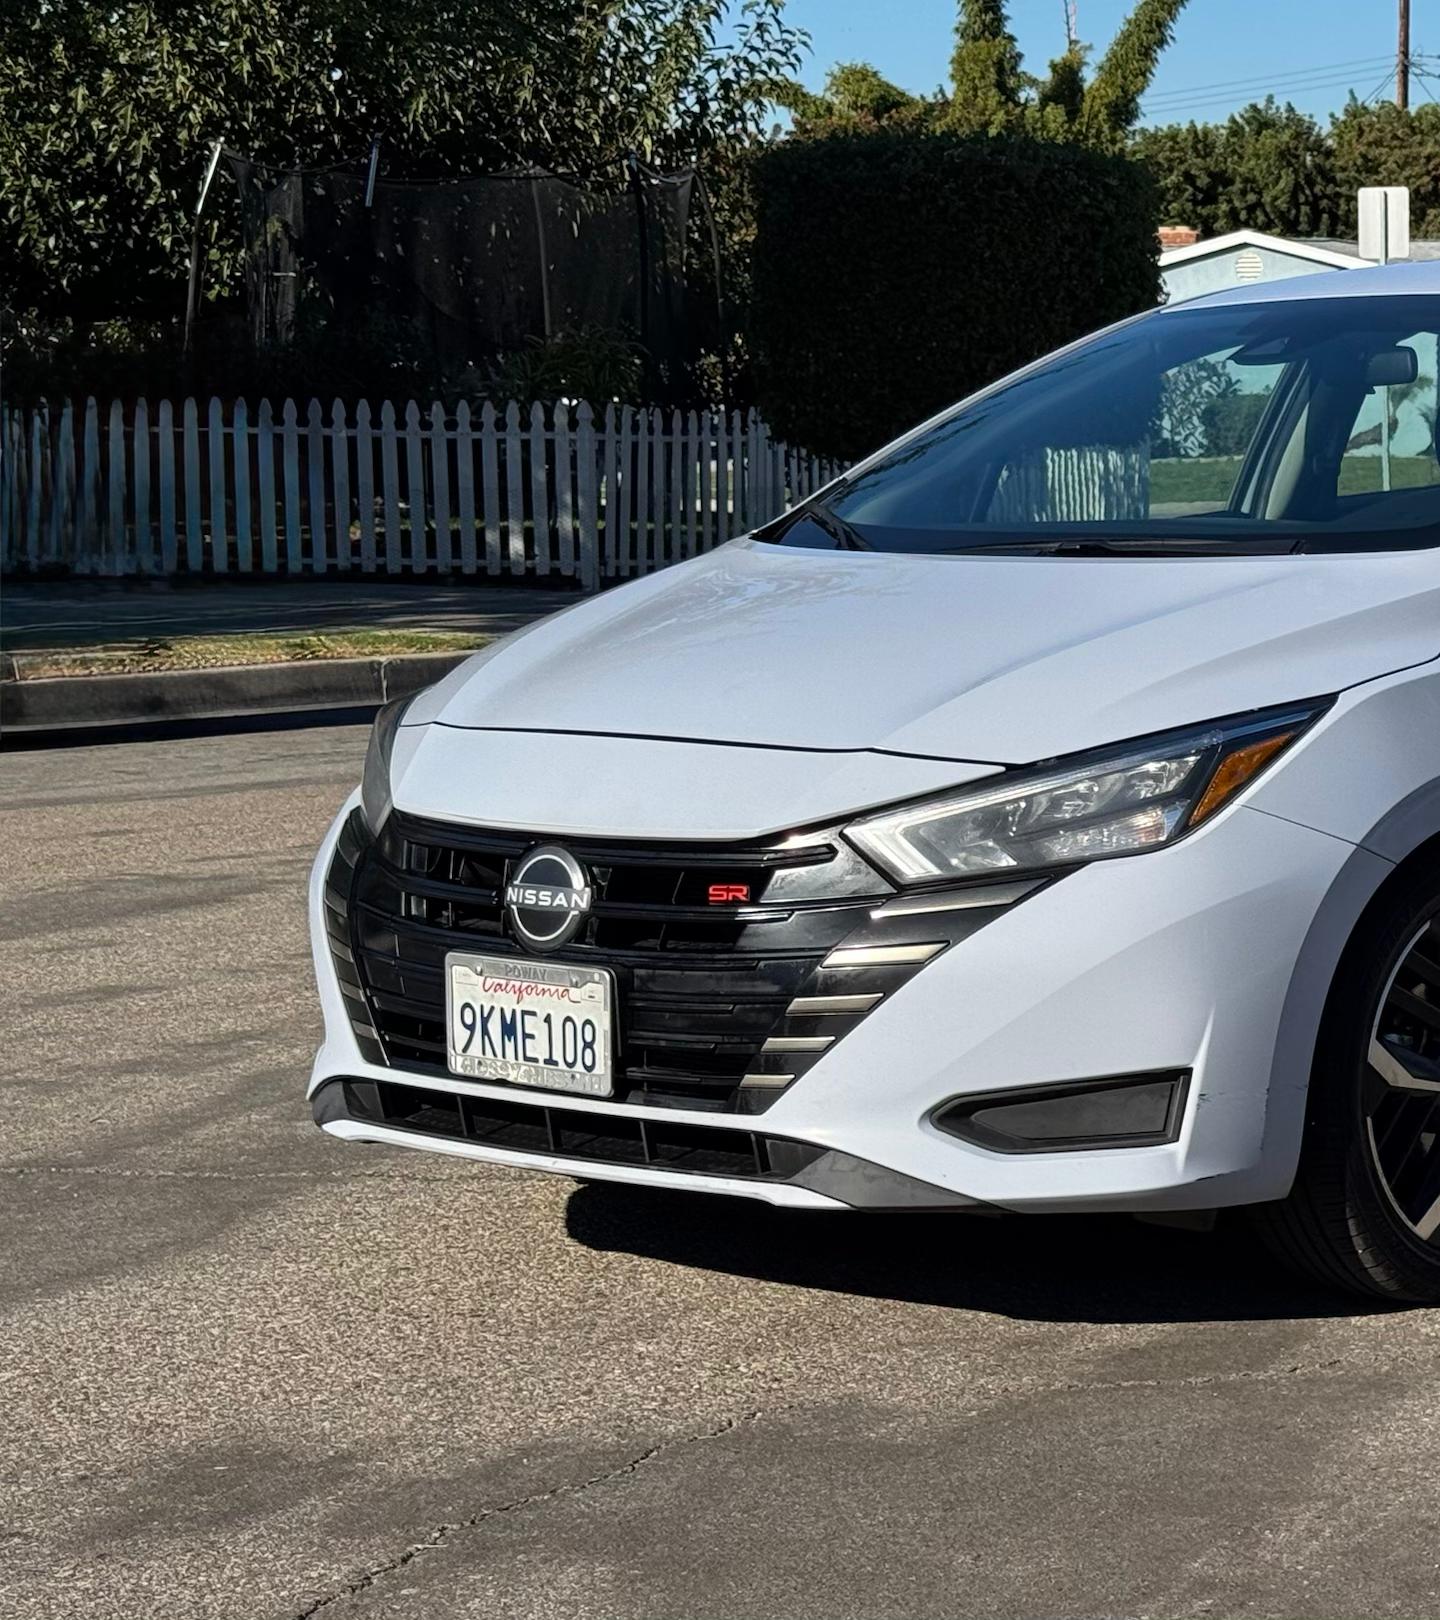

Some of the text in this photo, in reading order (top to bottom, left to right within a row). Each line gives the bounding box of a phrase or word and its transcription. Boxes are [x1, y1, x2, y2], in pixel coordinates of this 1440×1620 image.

[507, 886, 588, 909] NISSAN
[708, 885, 749, 903] SR
[504, 963, 547, 983] POWAY
[481, 975, 581, 1004] California
[460, 1002, 596, 1073] 9KME108
